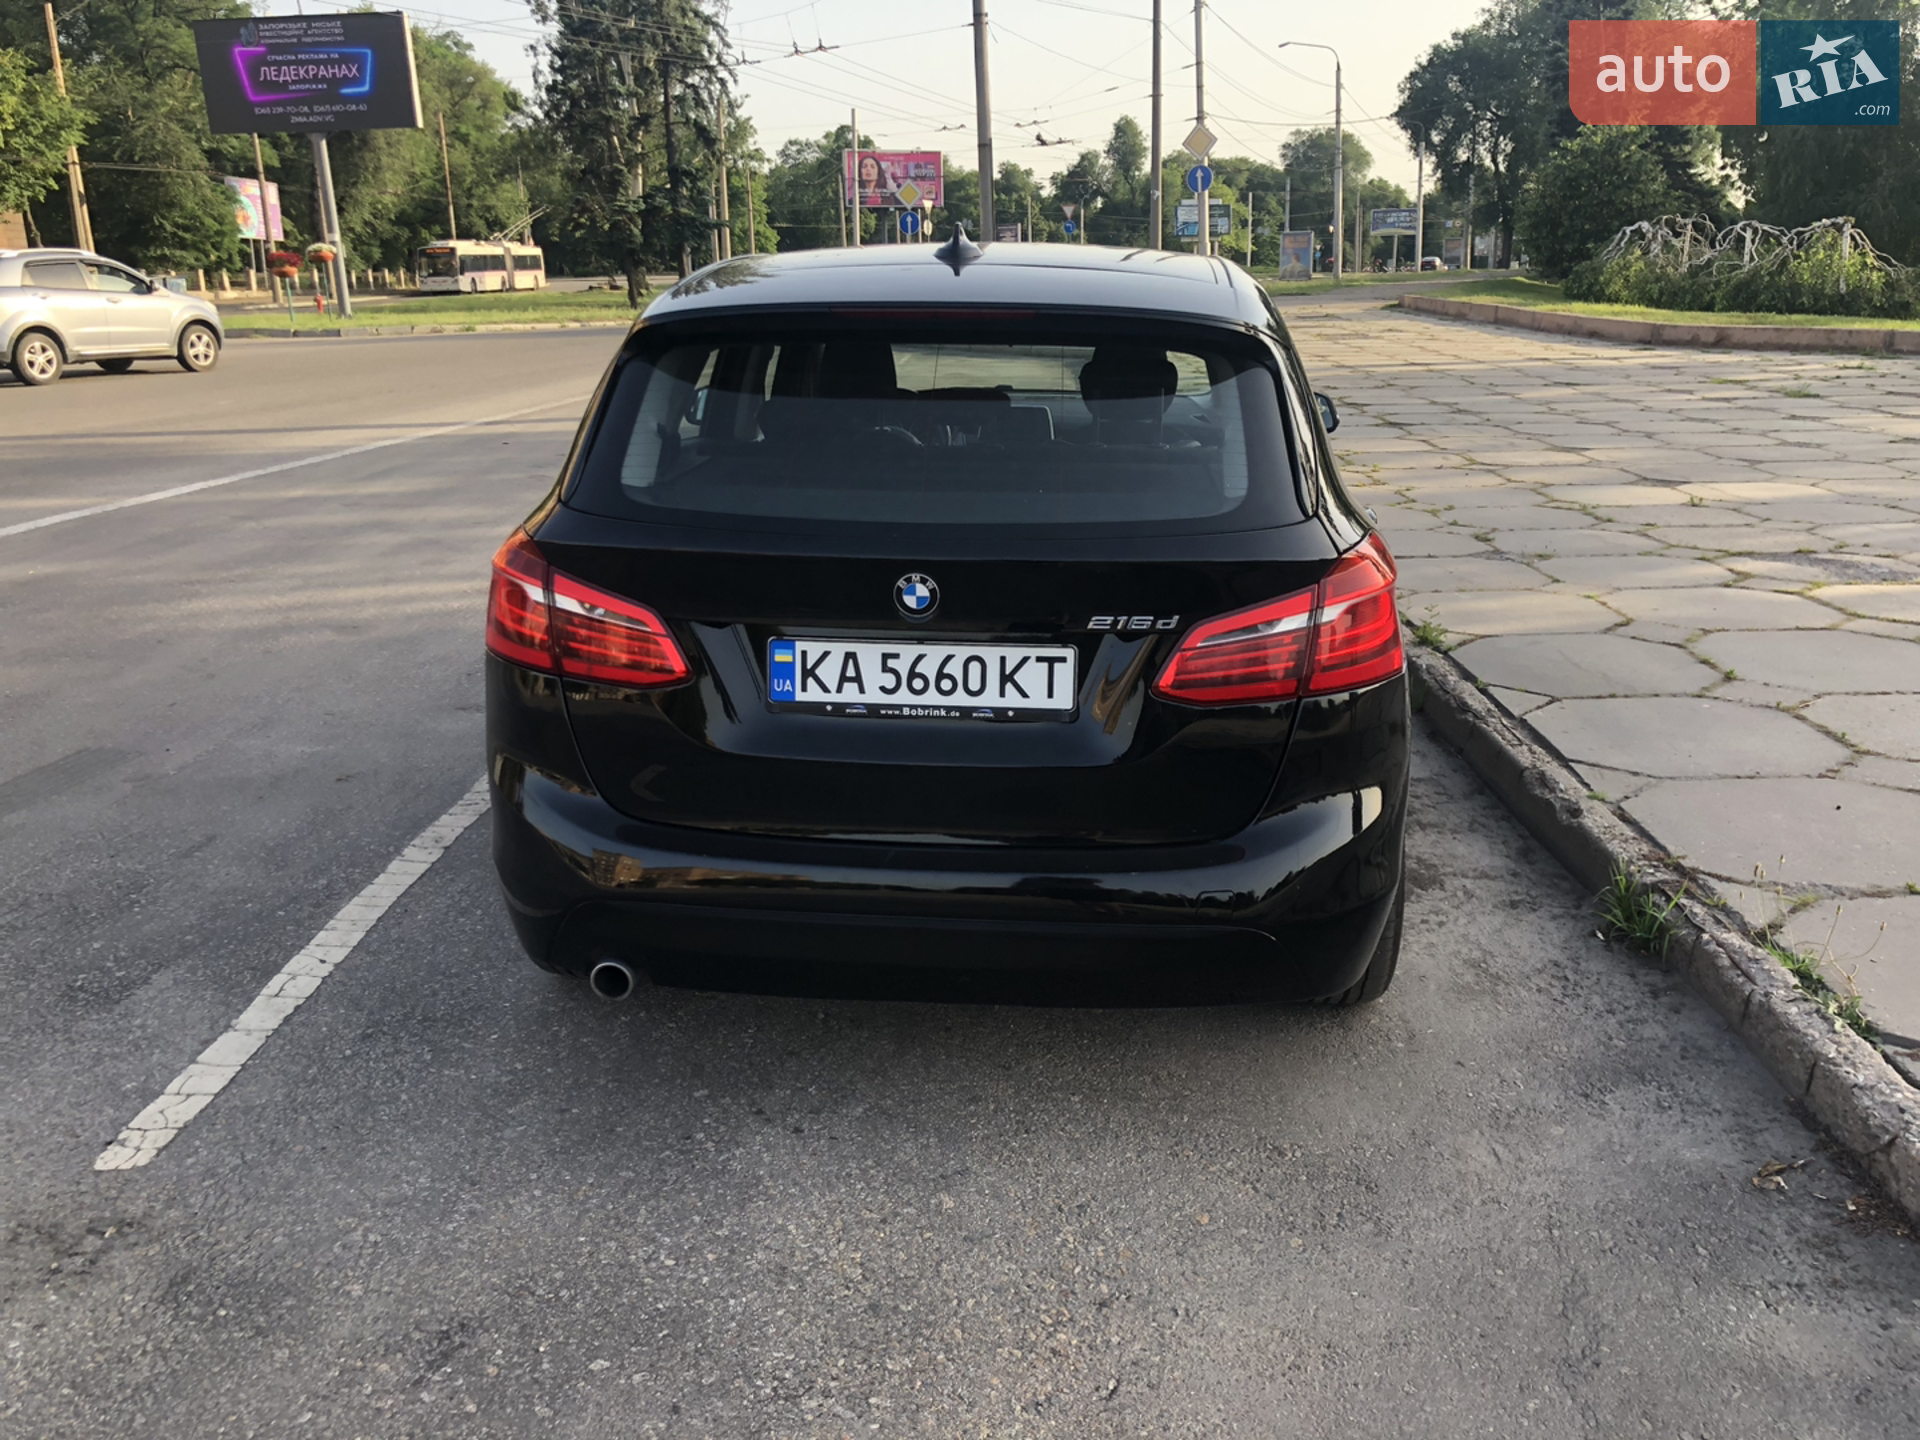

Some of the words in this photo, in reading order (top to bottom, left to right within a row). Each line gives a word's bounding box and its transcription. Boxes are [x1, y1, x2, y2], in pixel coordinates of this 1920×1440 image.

[260, 64, 359, 82] ЛЕДЕКРАНАХ
[1087, 615, 1180, 630] 216d
[800, 650, 866, 694] KA
[878, 652, 988, 698] 5660
[999, 655, 1068, 699] KT
[773, 678, 793, 692] UA
[880, 706, 960, 718] www.Bobrink.de
